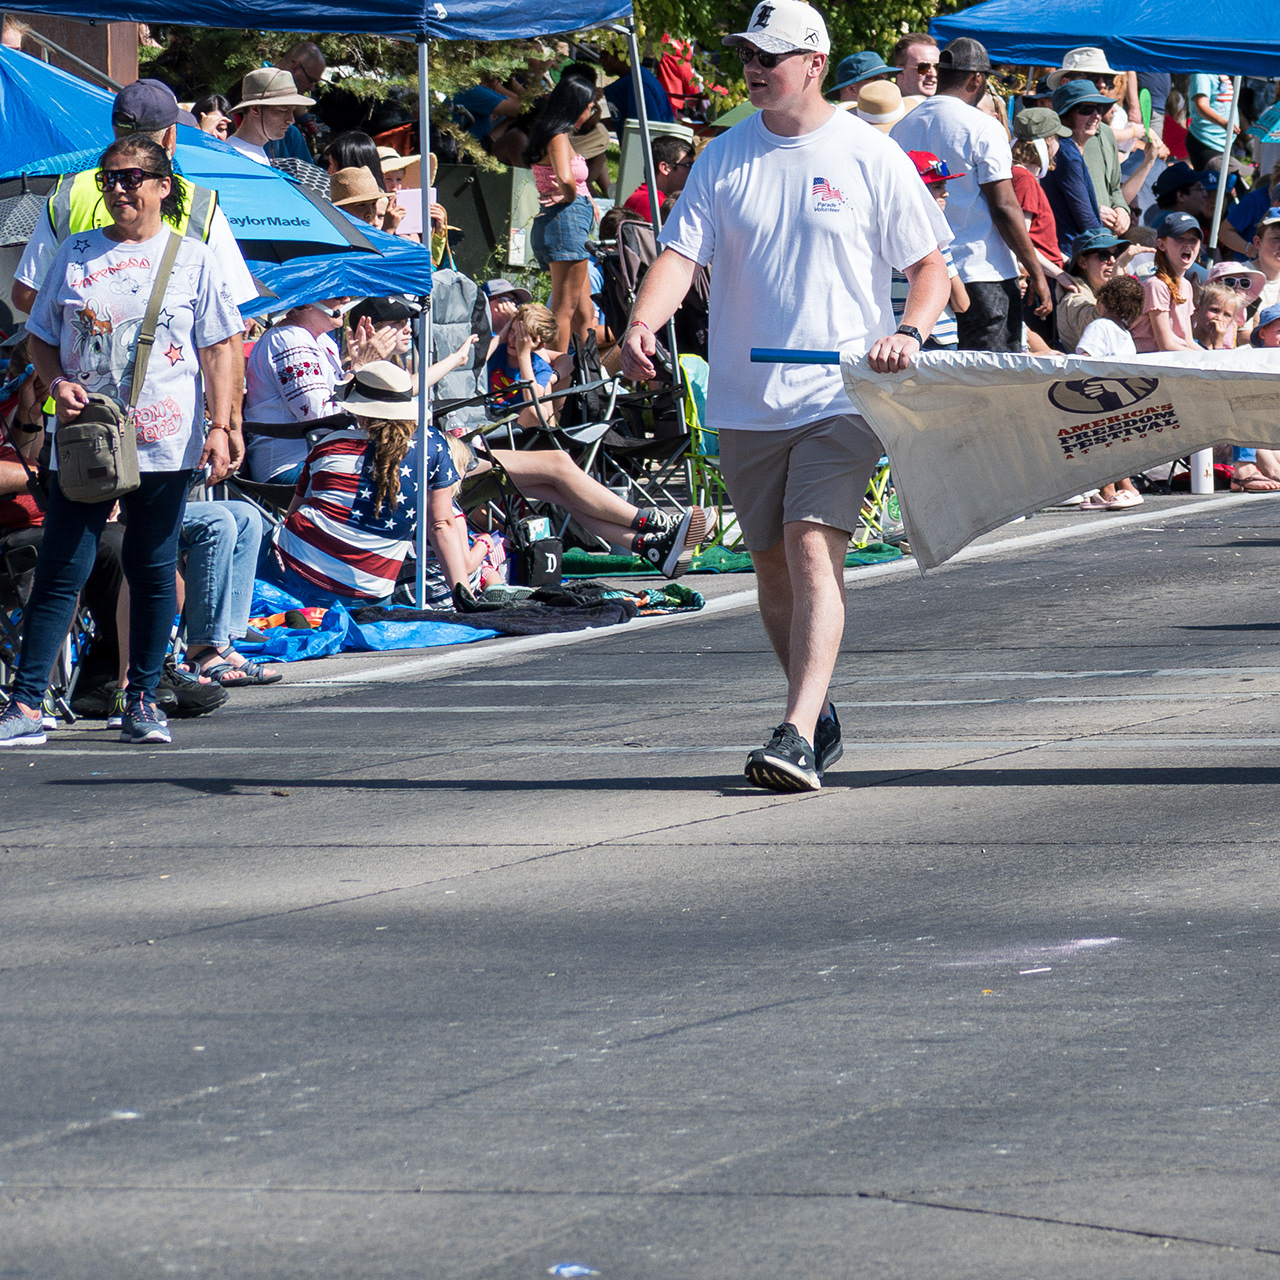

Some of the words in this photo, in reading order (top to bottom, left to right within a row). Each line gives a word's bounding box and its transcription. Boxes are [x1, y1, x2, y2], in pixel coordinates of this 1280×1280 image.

[1056, 402, 1174, 437] AMERICA'S
[1058, 409, 1177, 446] FREEDOM
[1061, 418, 1180, 454] FESTIVAL
[544, 551, 557, 574] D
